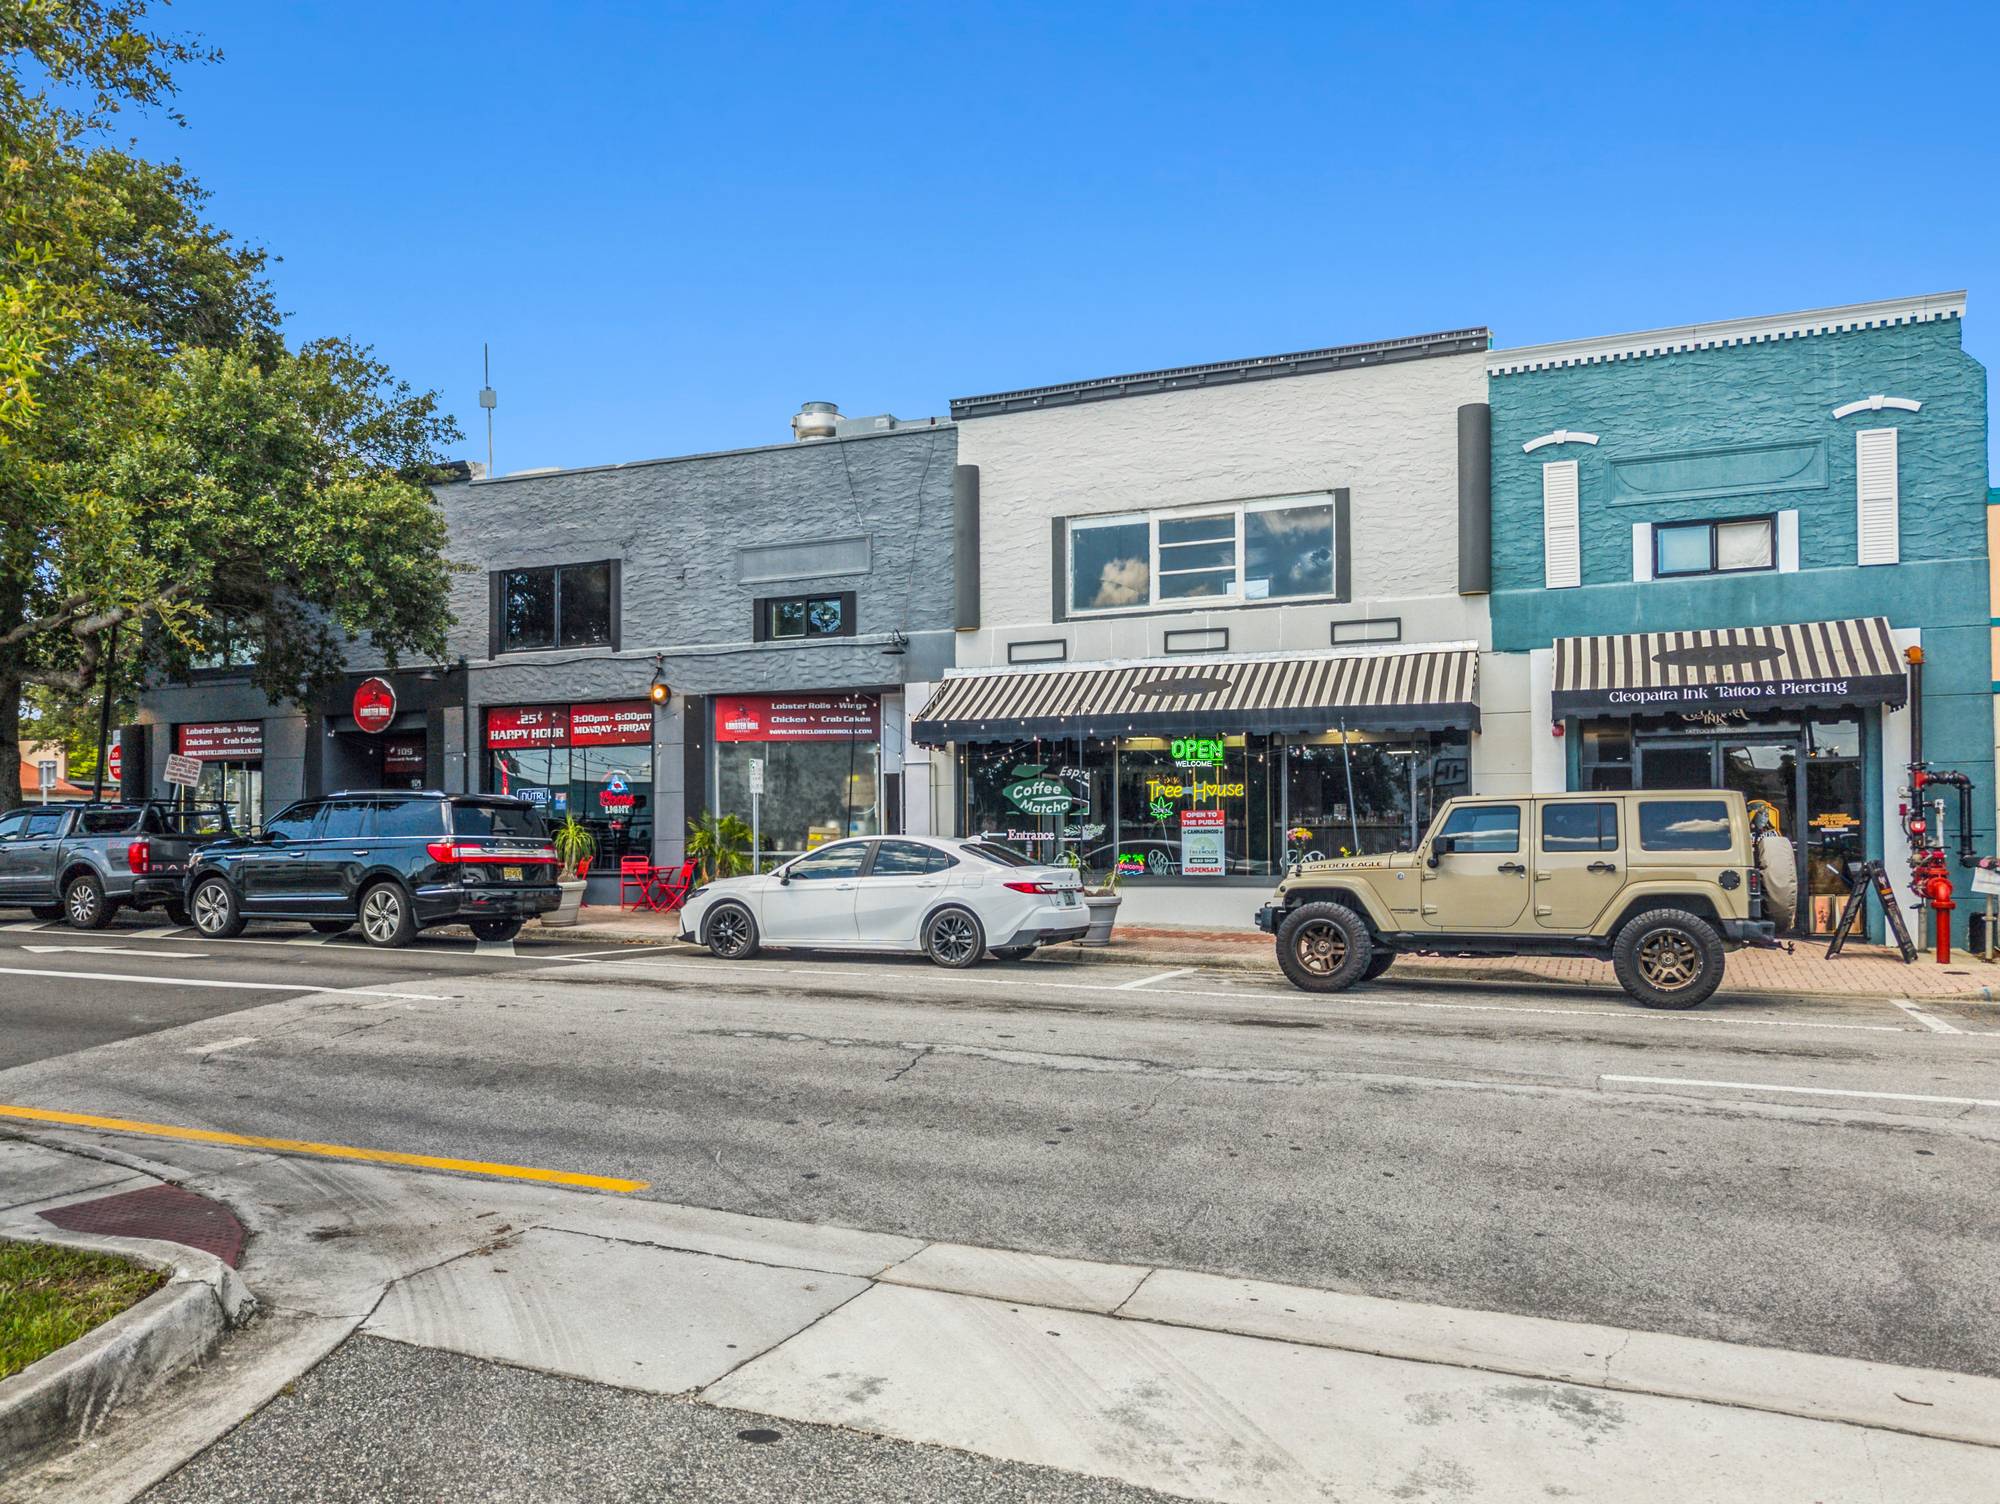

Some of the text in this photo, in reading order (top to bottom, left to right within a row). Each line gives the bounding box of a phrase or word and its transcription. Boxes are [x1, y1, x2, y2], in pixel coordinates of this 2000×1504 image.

[1609, 681, 1847, 704] Cleopatra Ink Tattoo & Piercing
[771, 702, 867, 711] Lobster Rolls Wings
[573, 714, 609, 724] 3:00pm
[614, 711, 652, 722] 6:00pm
[770, 716, 807, 724] Chicken
[186, 725, 260, 735] Lobster Rolls Wings
[574, 725, 611, 735] MONDAY
[618, 722, 651, 734] FRIDAY
[725, 722, 747, 730] LOBSTER
[490, 727, 565, 740] HAPPY HOUR
[223, 737, 240, 745] Crab
[1171, 739, 1224, 759] OPEN
[1175, 760, 1213, 768] WELCOME
[1012, 781, 1062, 799] Coffee
[1145, 780, 1183, 802] Tree
[604, 805, 629, 814] LIGHT
[1020, 799, 1070, 813] Matcha
[1007, 828, 1055, 841] Entrance
[1309, 862, 1349, 870] GOLDEN
